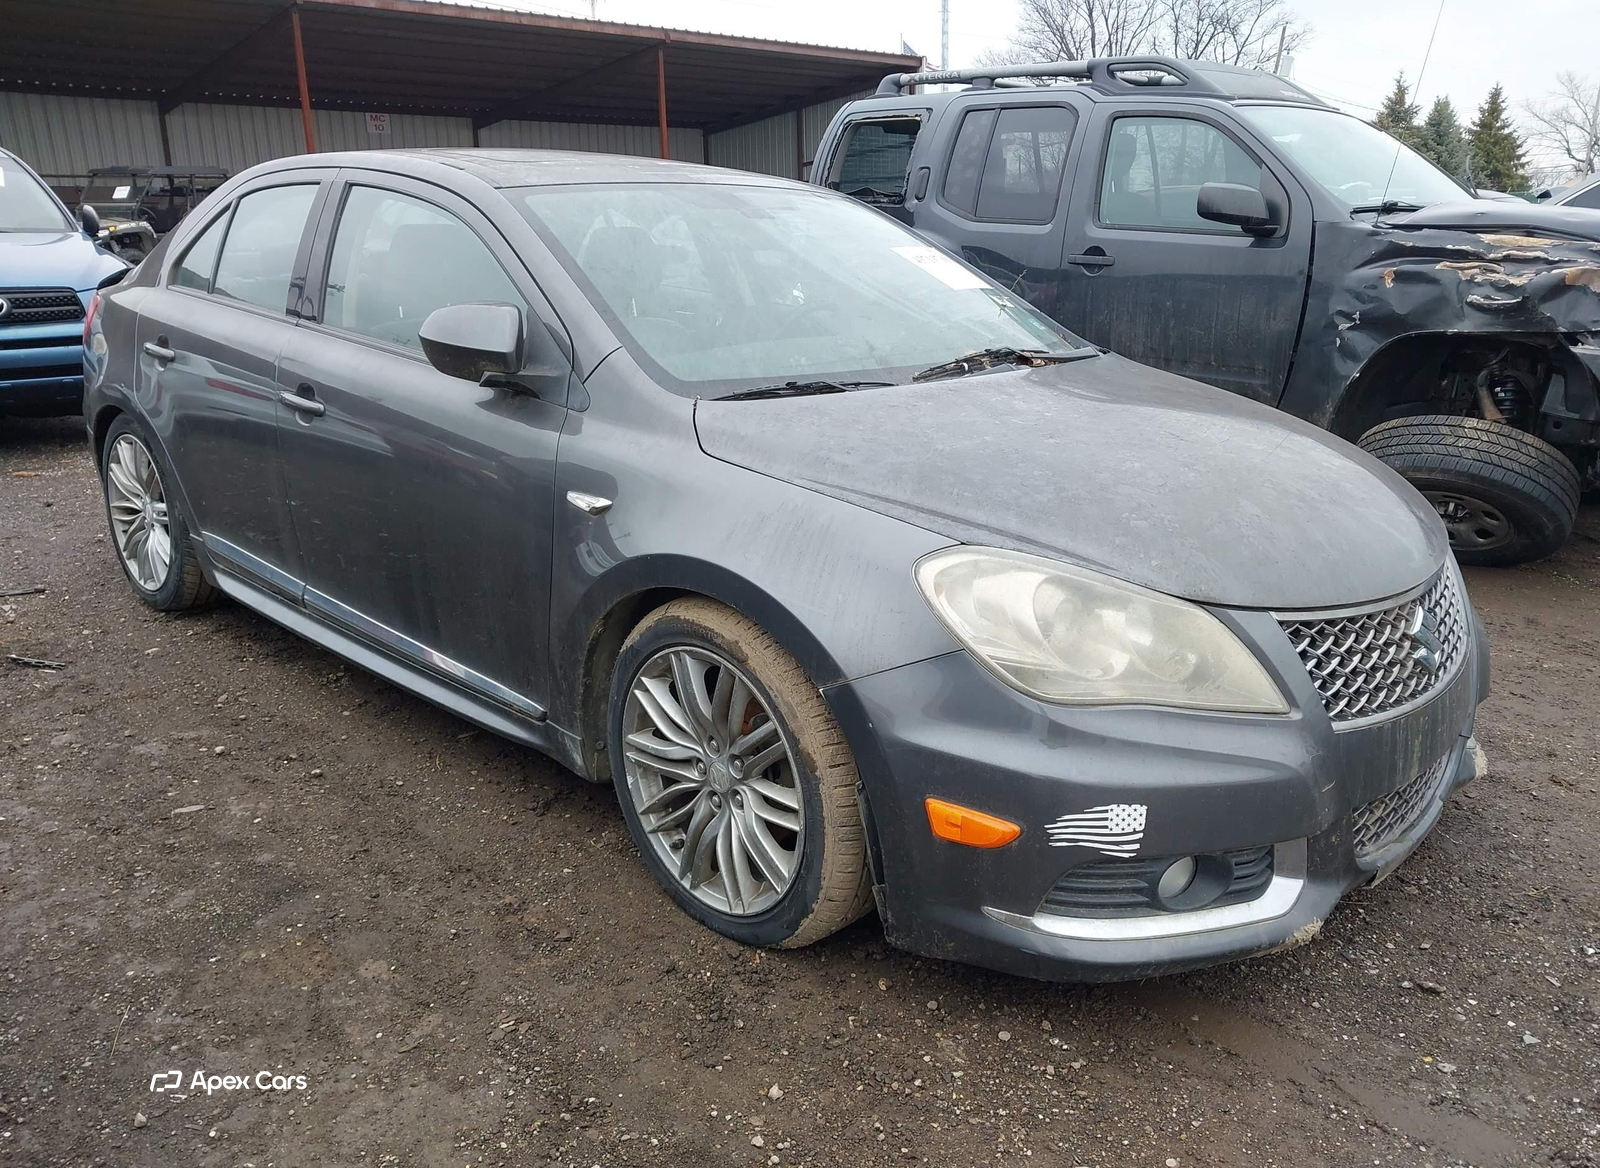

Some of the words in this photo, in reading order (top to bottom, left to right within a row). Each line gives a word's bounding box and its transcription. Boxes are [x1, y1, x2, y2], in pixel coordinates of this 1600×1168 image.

[907, 71, 959, 83] XTERRA
[369, 114, 386, 123] MC
[374, 124, 385, 132] 10
